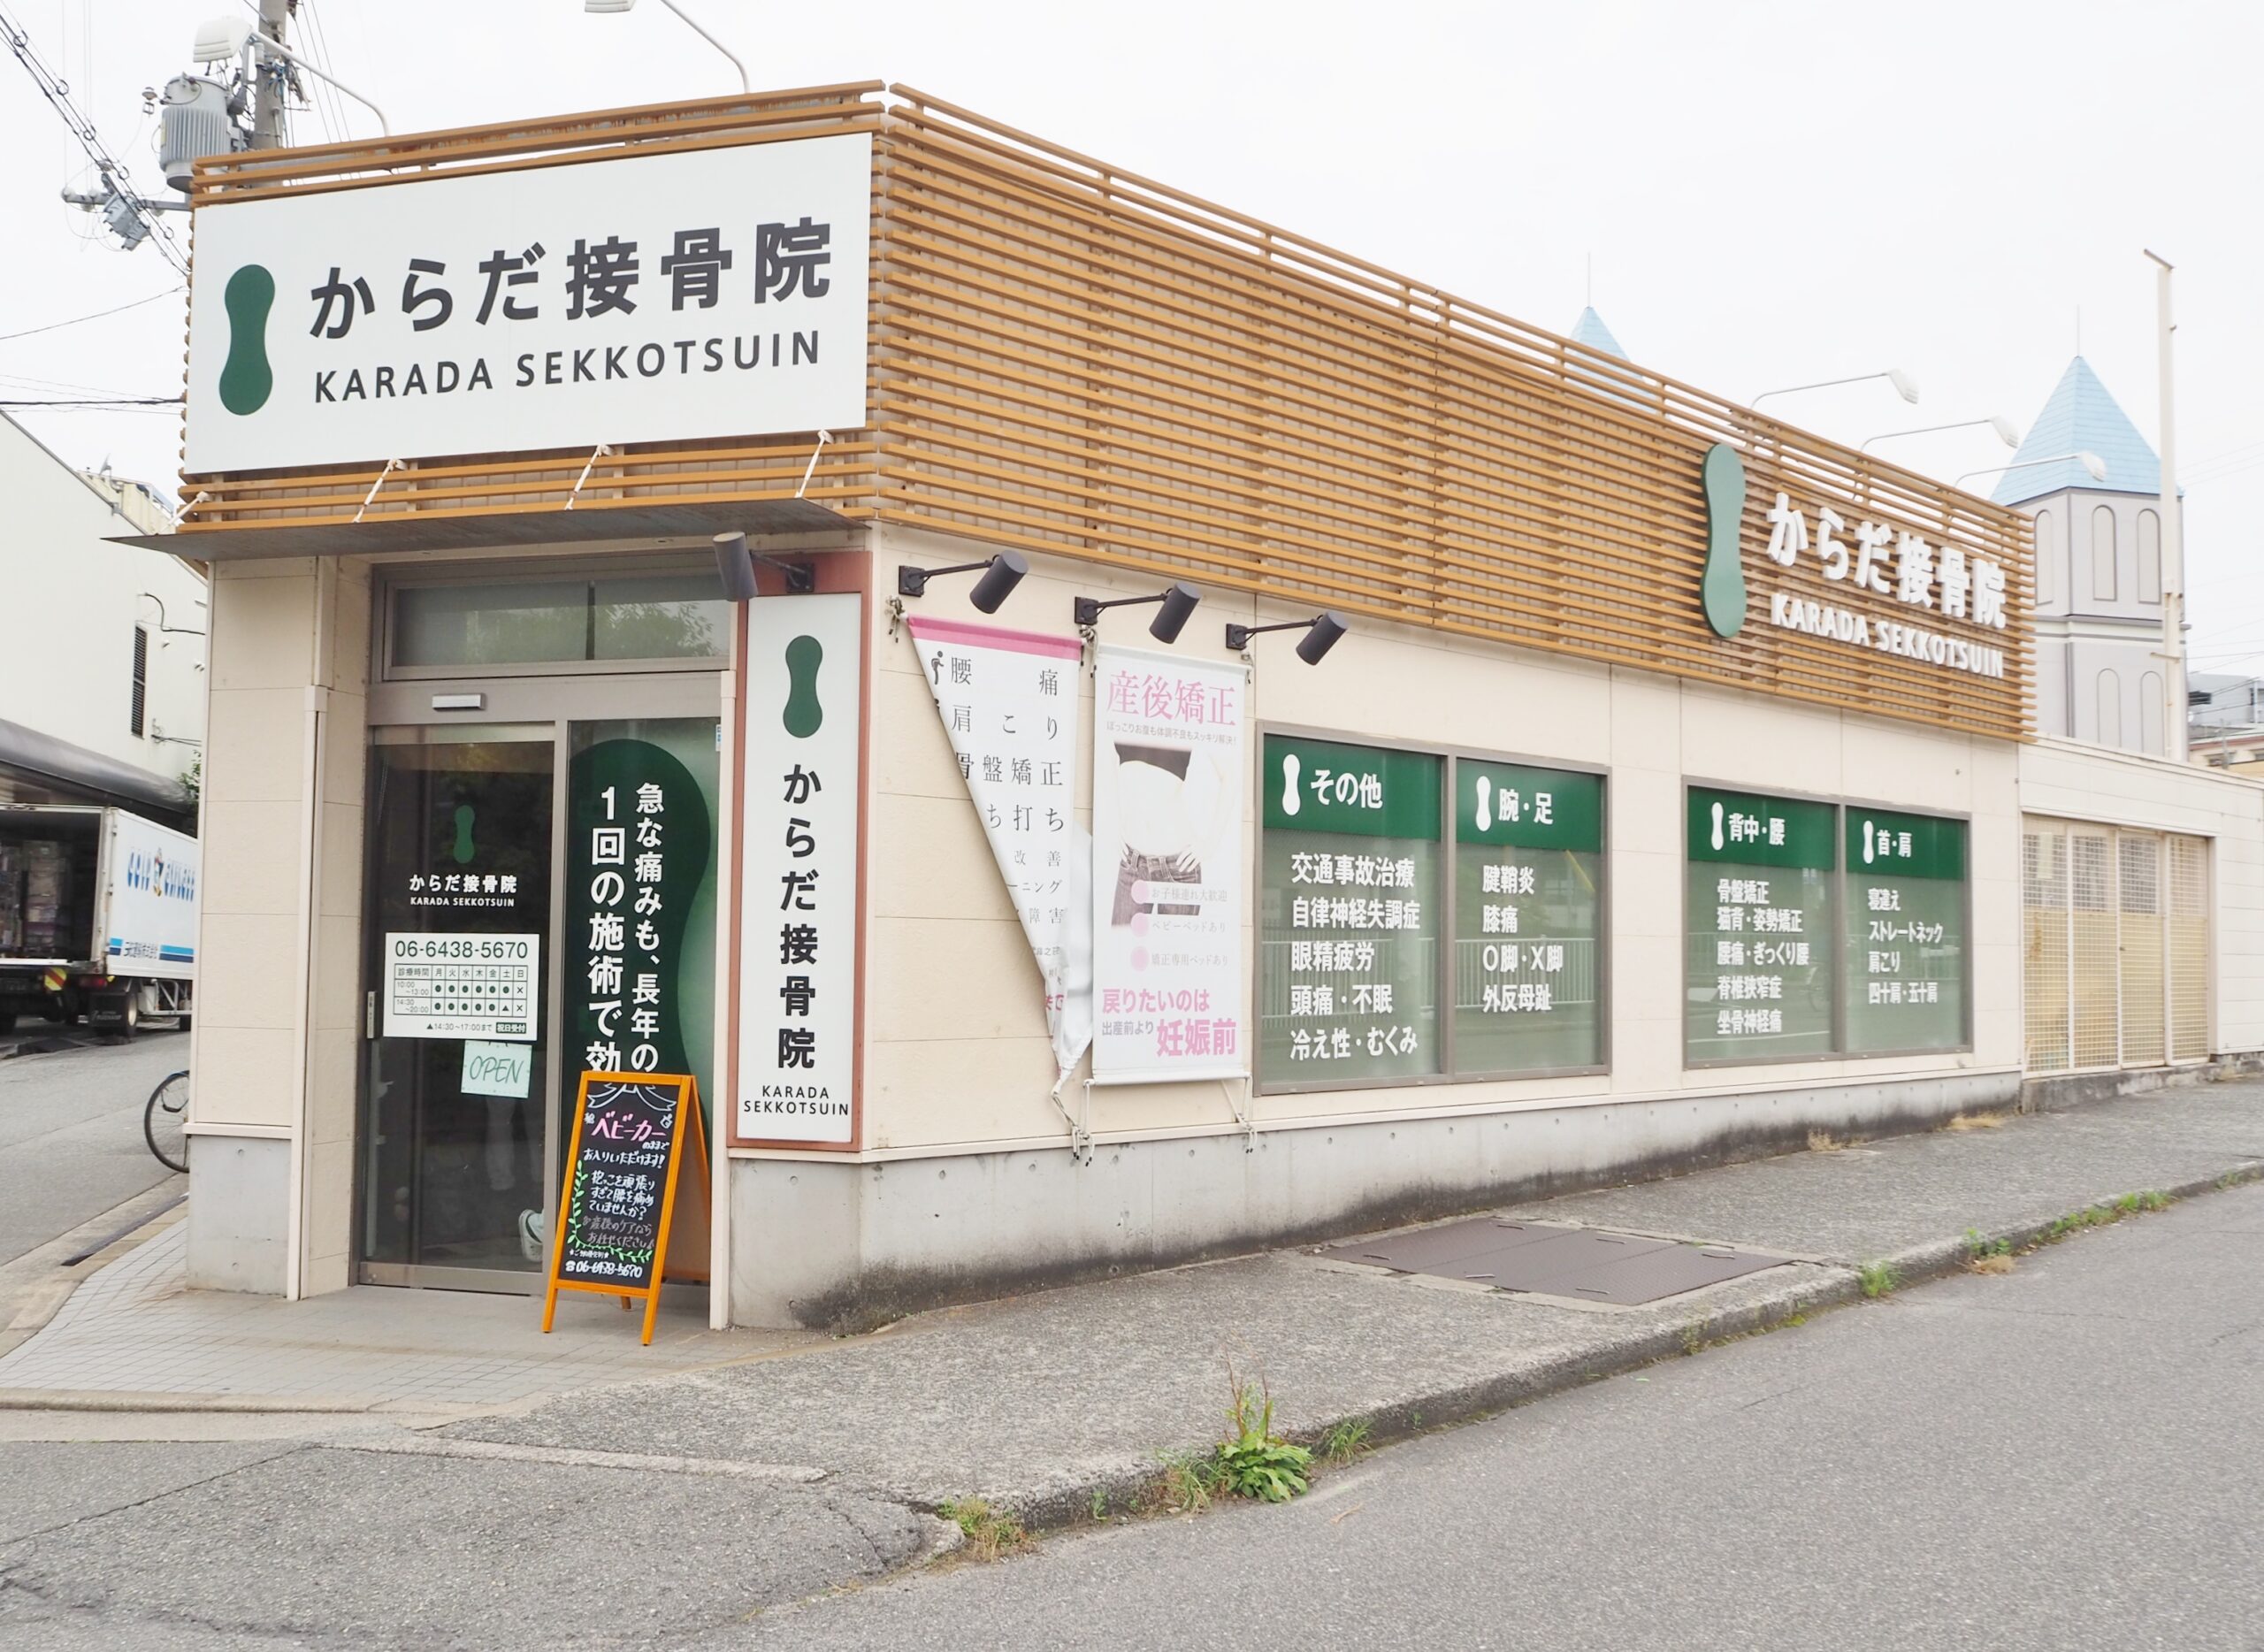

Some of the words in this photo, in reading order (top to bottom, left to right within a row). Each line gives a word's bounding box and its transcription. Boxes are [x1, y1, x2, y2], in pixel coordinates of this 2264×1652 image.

[310, 217, 831, 340] からだ接骨院
[315, 357, 493, 403] KARADA
[516, 331, 820, 386] SEKKOTSUIN
[1766, 492, 2007, 629] からだ接骨院
[1771, 592, 1870, 647] KARADA
[1875, 621, 2003, 678] SEKKOTSUIN
[1106, 670, 1236, 726] 産後矯正
[1310, 769, 1383, 809] その他
[1498, 788, 1554, 824] 腕・足
[1729, 813, 1786, 846] 背中・腰
[1878, 830, 1912, 857] 首・肩
[1291, 852, 1415, 888] 交通事故治療
[1482, 865, 1535, 895] 腱鞘炎
[409, 874, 517, 894] からだ接骨院
[1717, 878, 1770, 905] 骨盤矯正
[410, 897, 449, 906] KARADA
[453, 898, 515, 907] SEKKOTSUIN
[1291, 896, 1420, 929] 自律神経失調症
[1868, 888, 1901, 912] 寝違え
[631, 782, 664, 1072] 急な痛みも、長年の
[778, 764, 822, 1068] からだ接骨院
[1482, 905, 1518, 934] 膝痛
[1717, 906, 1803, 933] 猫背・姿勢矯正
[1869, 921, 1943, 944] ストレートネック
[395, 940, 528, 959] 06-6438-5670
[1290, 941, 1375, 972] 眼精疲労
[1717, 941, 1809, 966] 腰痛・ぎっくり腰
[1868, 951, 1901, 974] 肩こり
[398, 967, 430, 977] 診療時間
[462, 968, 470, 977] 水
[476, 968, 484, 977] 木
[488, 968, 497, 977] 金
[1102, 989, 1210, 1013] 戻りたいのは
[1290, 984, 1393, 1016] 頭痛・不眠
[1482, 984, 1552, 1013] 外反母趾
[1869, 982, 1938, 1005] 四十肩・五十肩
[497, 1023, 526, 1033] 祝日受付
[1102, 1021, 1154, 1036] 出産前より
[1717, 1009, 1782, 1035] 坐骨神経痛
[1157, 1018, 1236, 1057] 妊娠前
[1290, 1026, 1418, 1060] 冷え性・むくみ
[470, 1055, 524, 1084] OPEN
[762, 1085, 830, 1098] KARADA
[744, 1100, 849, 1115] SEKKOTSUIN
[592, 1111, 666, 1142] ベビーカー
[576, 1261, 643, 1278] 06-6438-5670
